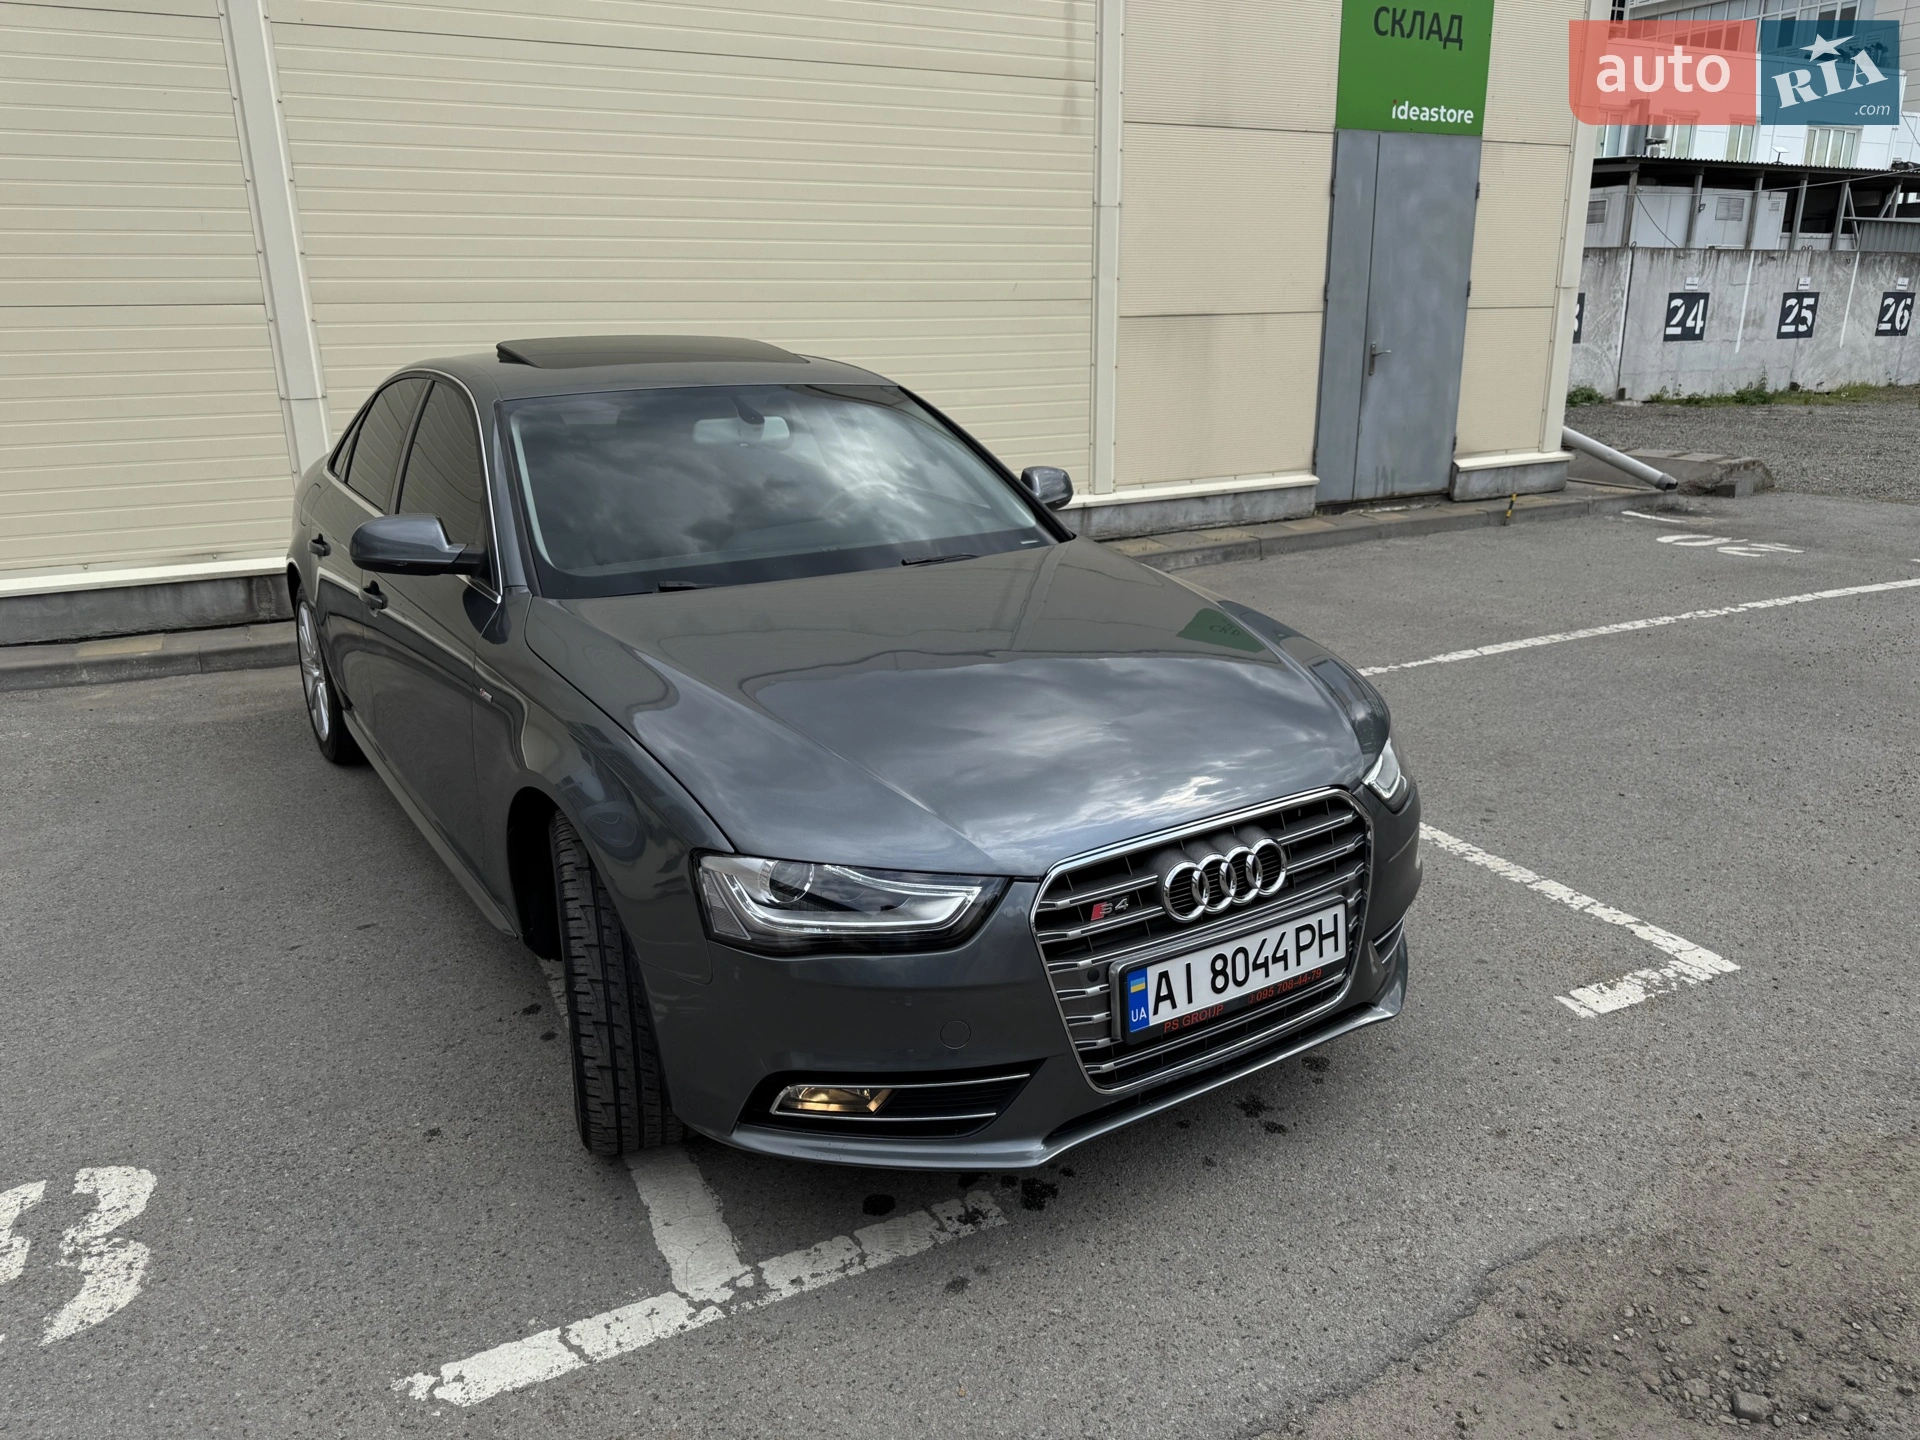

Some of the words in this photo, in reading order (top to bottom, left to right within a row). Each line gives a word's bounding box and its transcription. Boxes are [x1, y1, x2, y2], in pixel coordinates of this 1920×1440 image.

[1374, 6, 1463, 51] СКЛАД
[1392, 99, 1475, 125] ideastore
[1665, 298, 1705, 335] 24
[1780, 297, 1816, 333] 25
[1877, 297, 1912, 331] 26
[1100, 898, 1129, 915] S4
[1131, 1007, 1147, 1023] UA
[1164, 1018, 1180, 1034] PS
[1182, 1004, 1224, 1027] GROUP
[1256, 986, 1275, 1001] 095
[1277, 968, 1323, 994] 708-44-79
